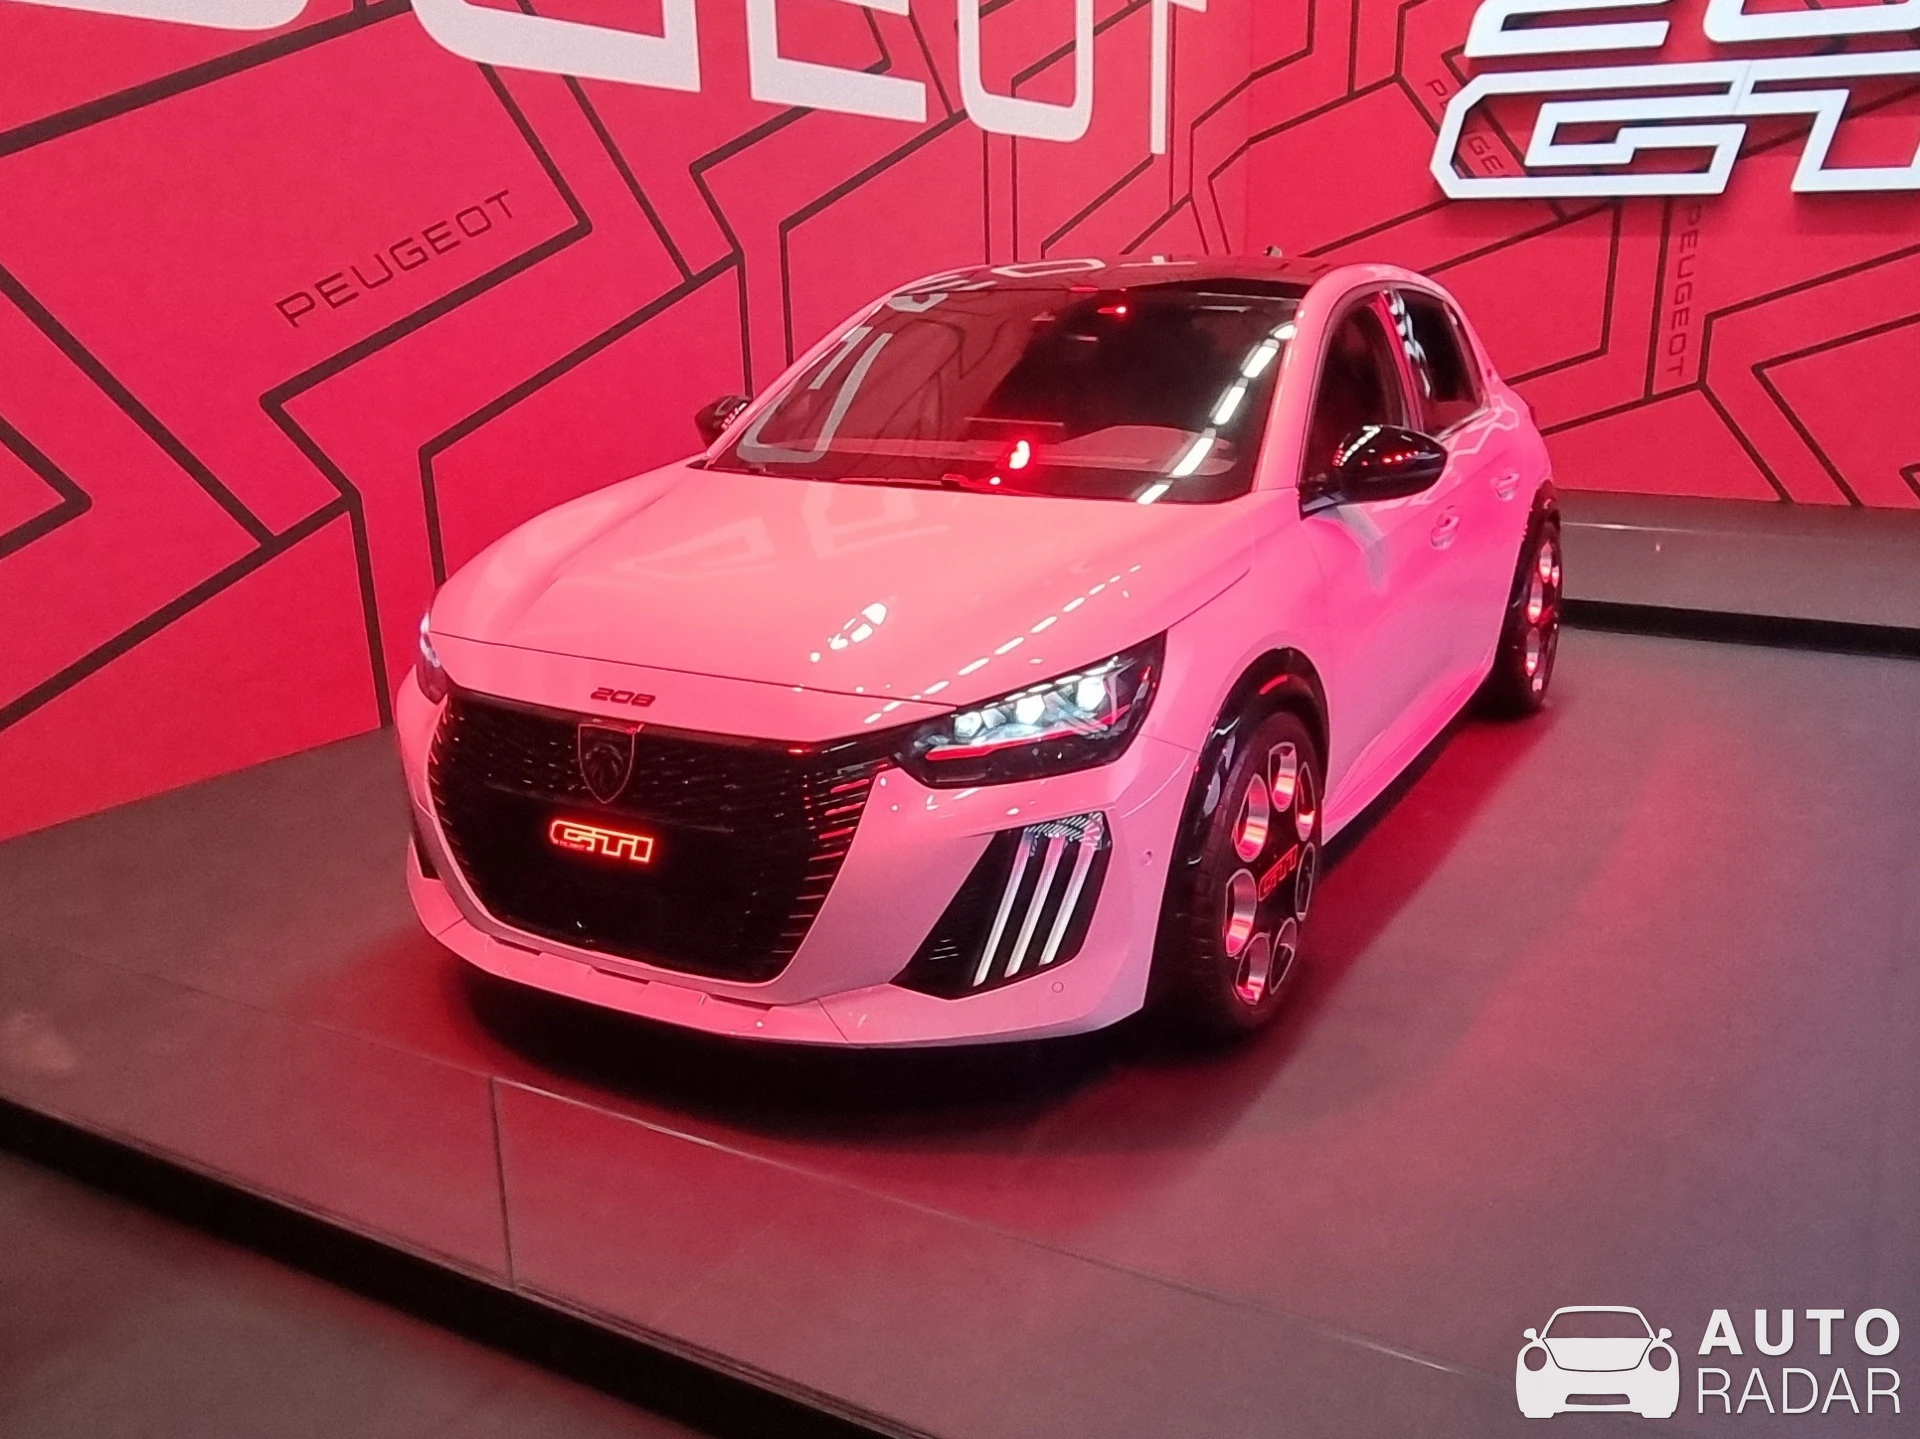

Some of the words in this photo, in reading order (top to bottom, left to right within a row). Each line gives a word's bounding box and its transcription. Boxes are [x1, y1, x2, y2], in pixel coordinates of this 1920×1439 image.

[275, 189, 513, 328] PEUGEOT
[1667, 204, 1702, 377] PEUGEOT
[590, 686, 656, 708] 208
